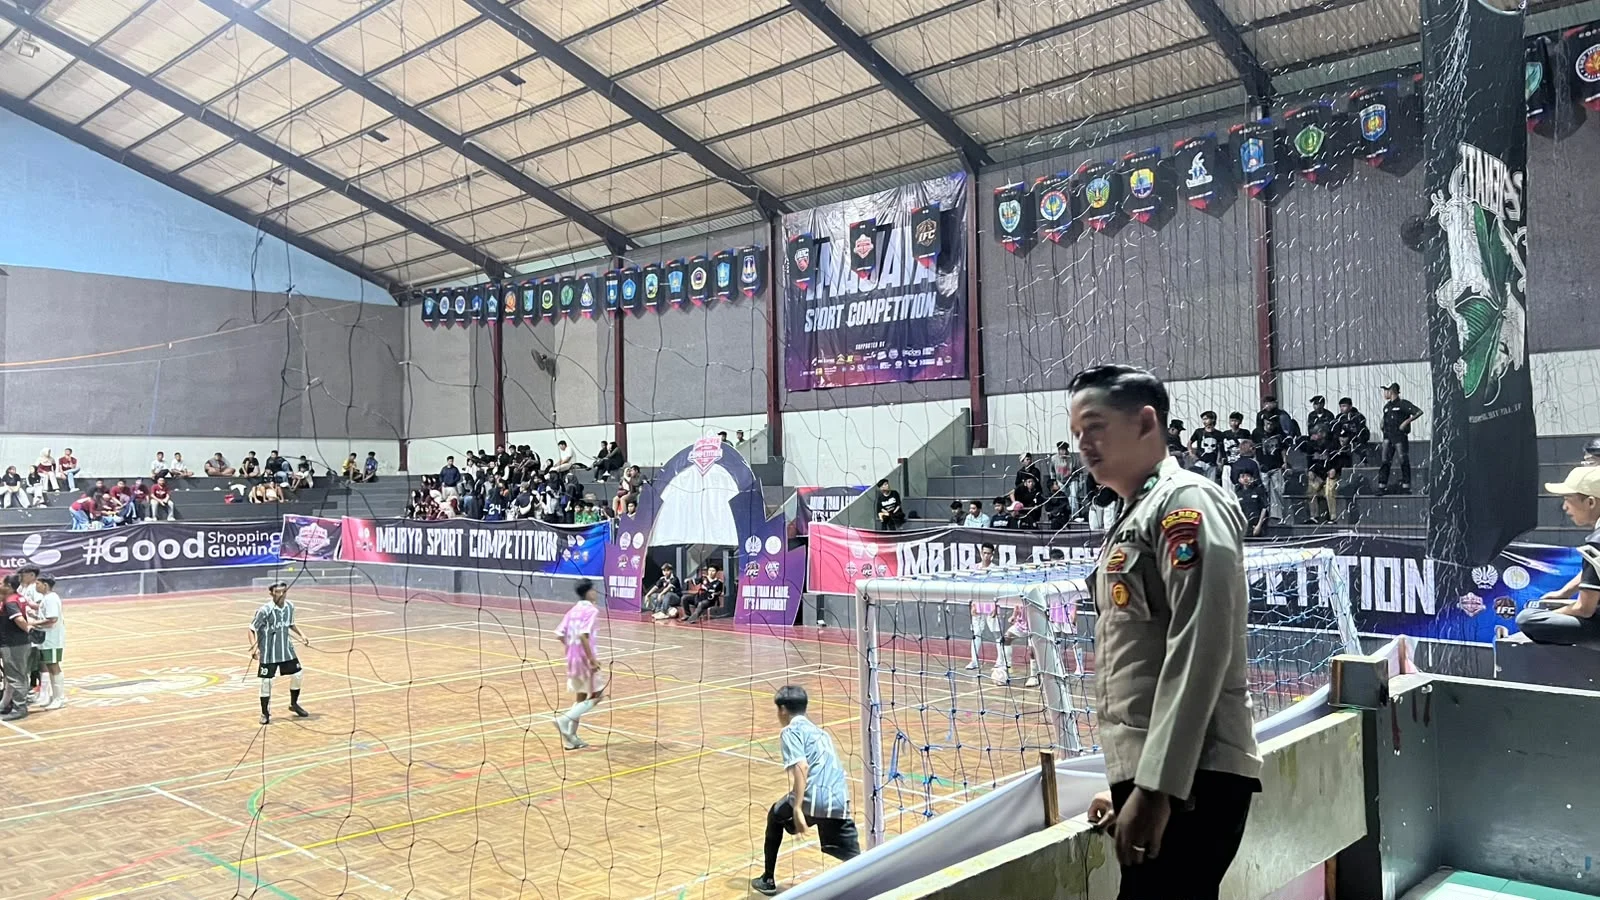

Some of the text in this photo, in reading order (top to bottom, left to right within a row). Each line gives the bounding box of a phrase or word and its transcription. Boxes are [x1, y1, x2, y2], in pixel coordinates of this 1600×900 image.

[804, 291, 937, 332] SPORT COMPETITION
[488, 503, 502, 515] 24
[207, 530, 281, 544] Shopping
[426, 527, 464, 557] SPORT
[468, 528, 559, 562] COMPETITION
[81, 531, 205, 565] #Good
[207, 543, 281, 558] Glowing
[1495, 606, 1515, 614] IFC
